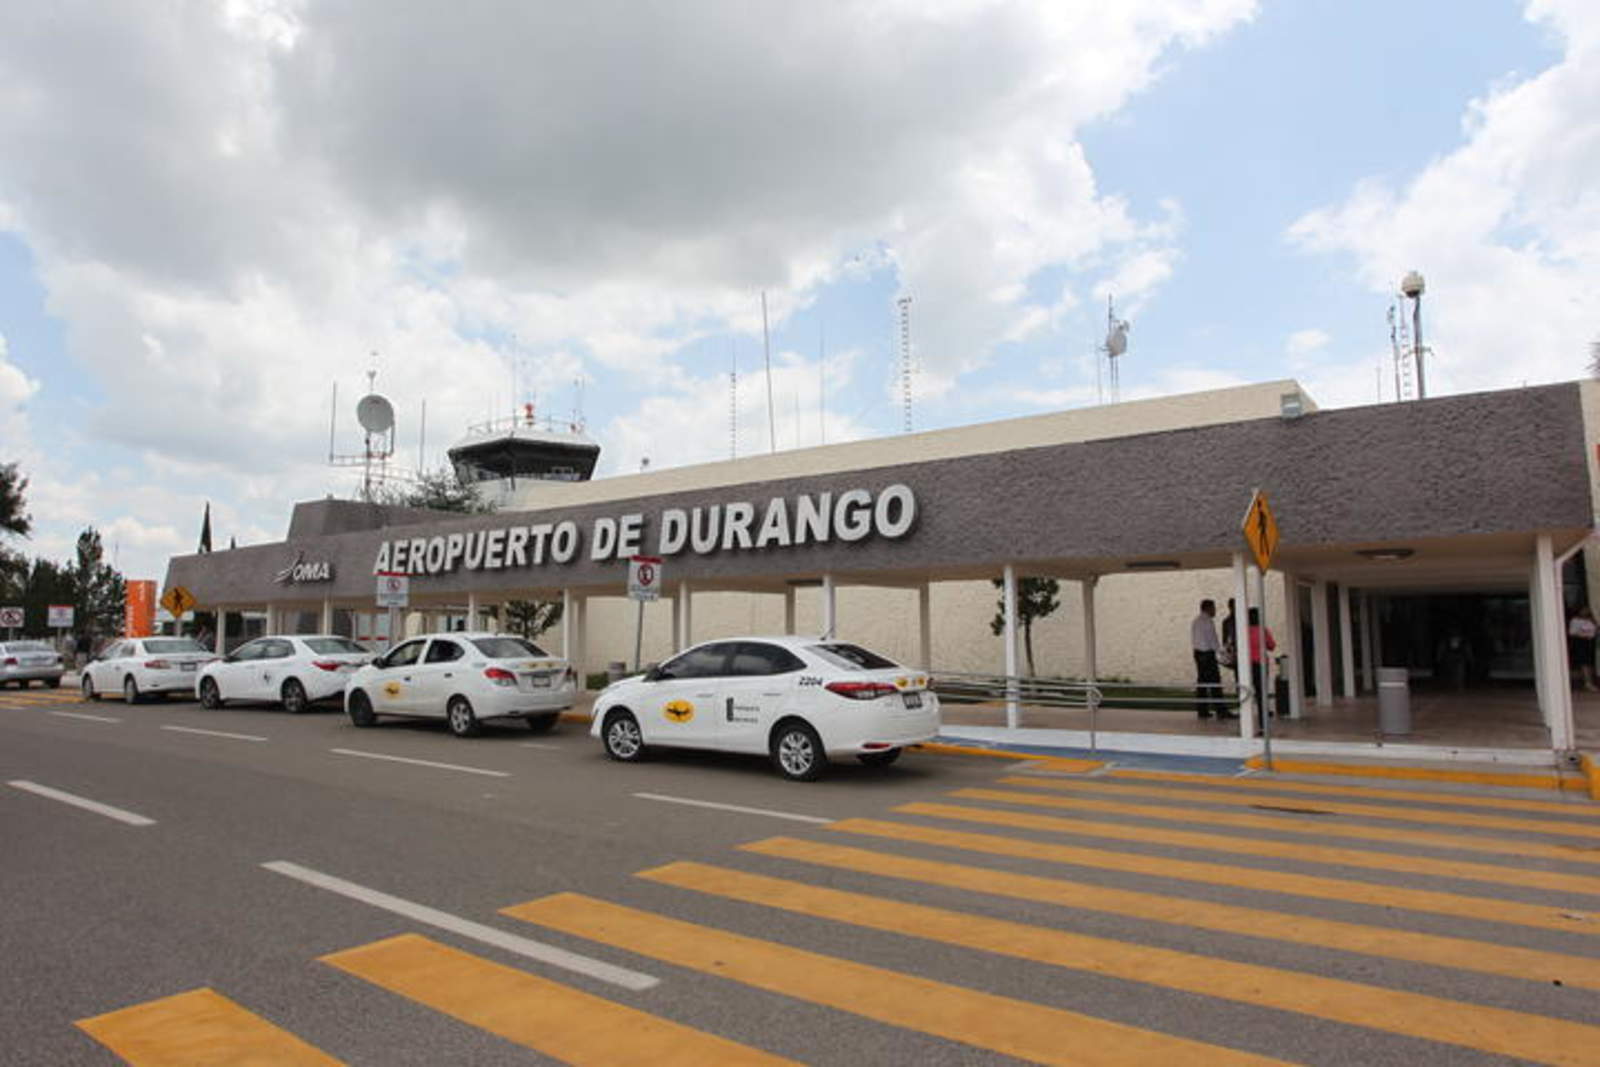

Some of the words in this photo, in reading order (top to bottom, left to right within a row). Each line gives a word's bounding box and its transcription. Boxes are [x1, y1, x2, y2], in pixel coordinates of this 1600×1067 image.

[373, 521, 577, 574] AEROPUERTO
[591, 514, 643, 560] DE
[659, 484, 915, 554] DURANGO
[293, 562, 330, 581] OMA
